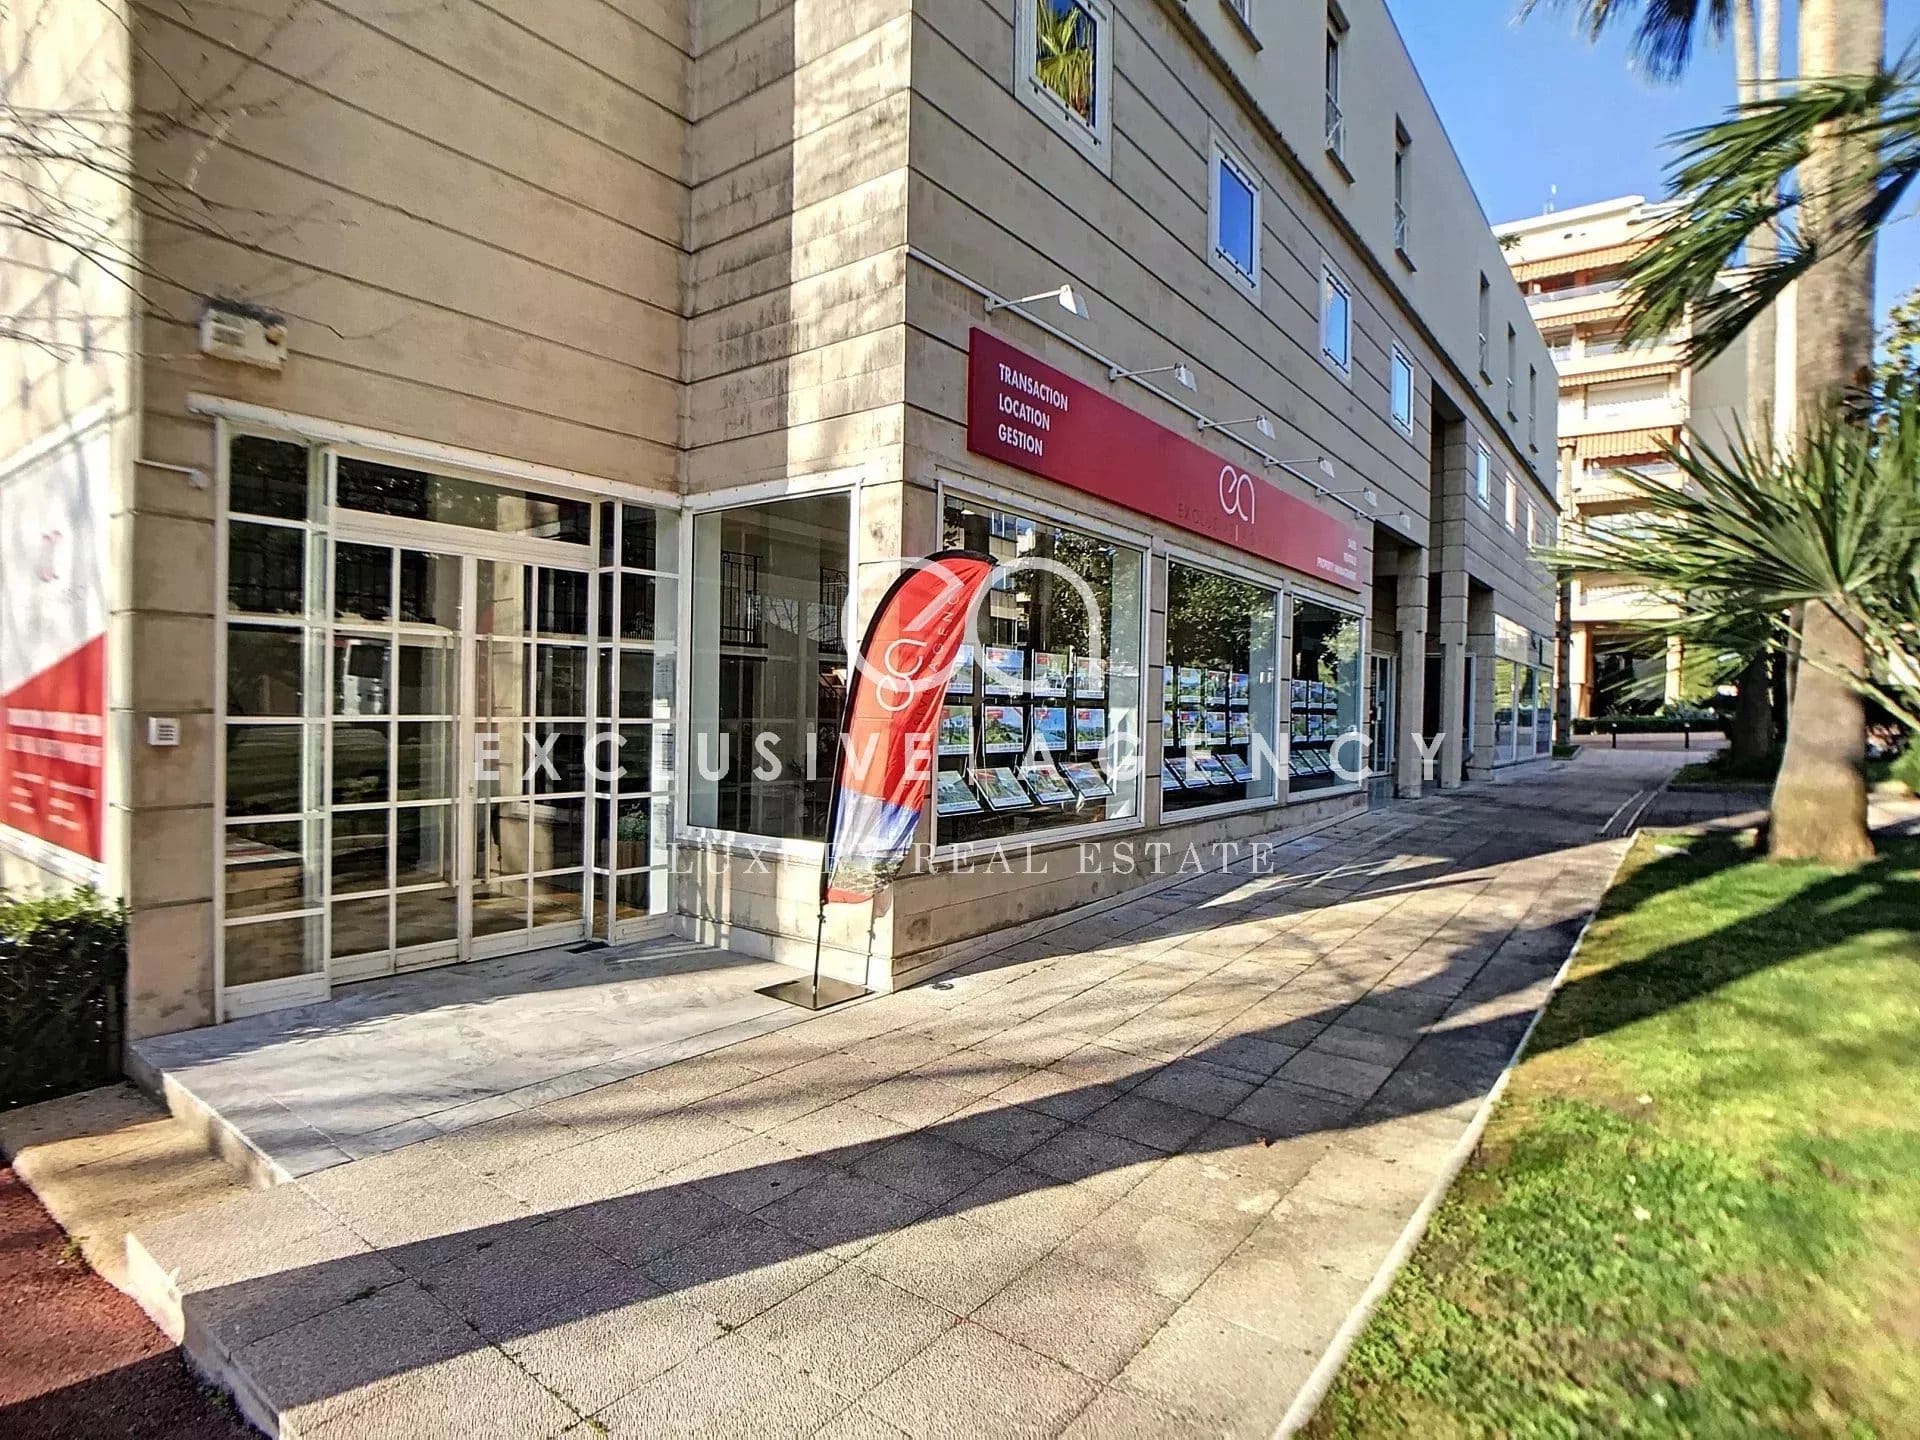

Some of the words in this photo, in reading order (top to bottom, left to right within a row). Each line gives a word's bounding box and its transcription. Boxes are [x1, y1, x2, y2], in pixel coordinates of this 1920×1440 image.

[998, 363, 1068, 412] TRANSACTION
[998, 393, 1050, 432] LOCATION
[998, 423, 1043, 457] GESTION
